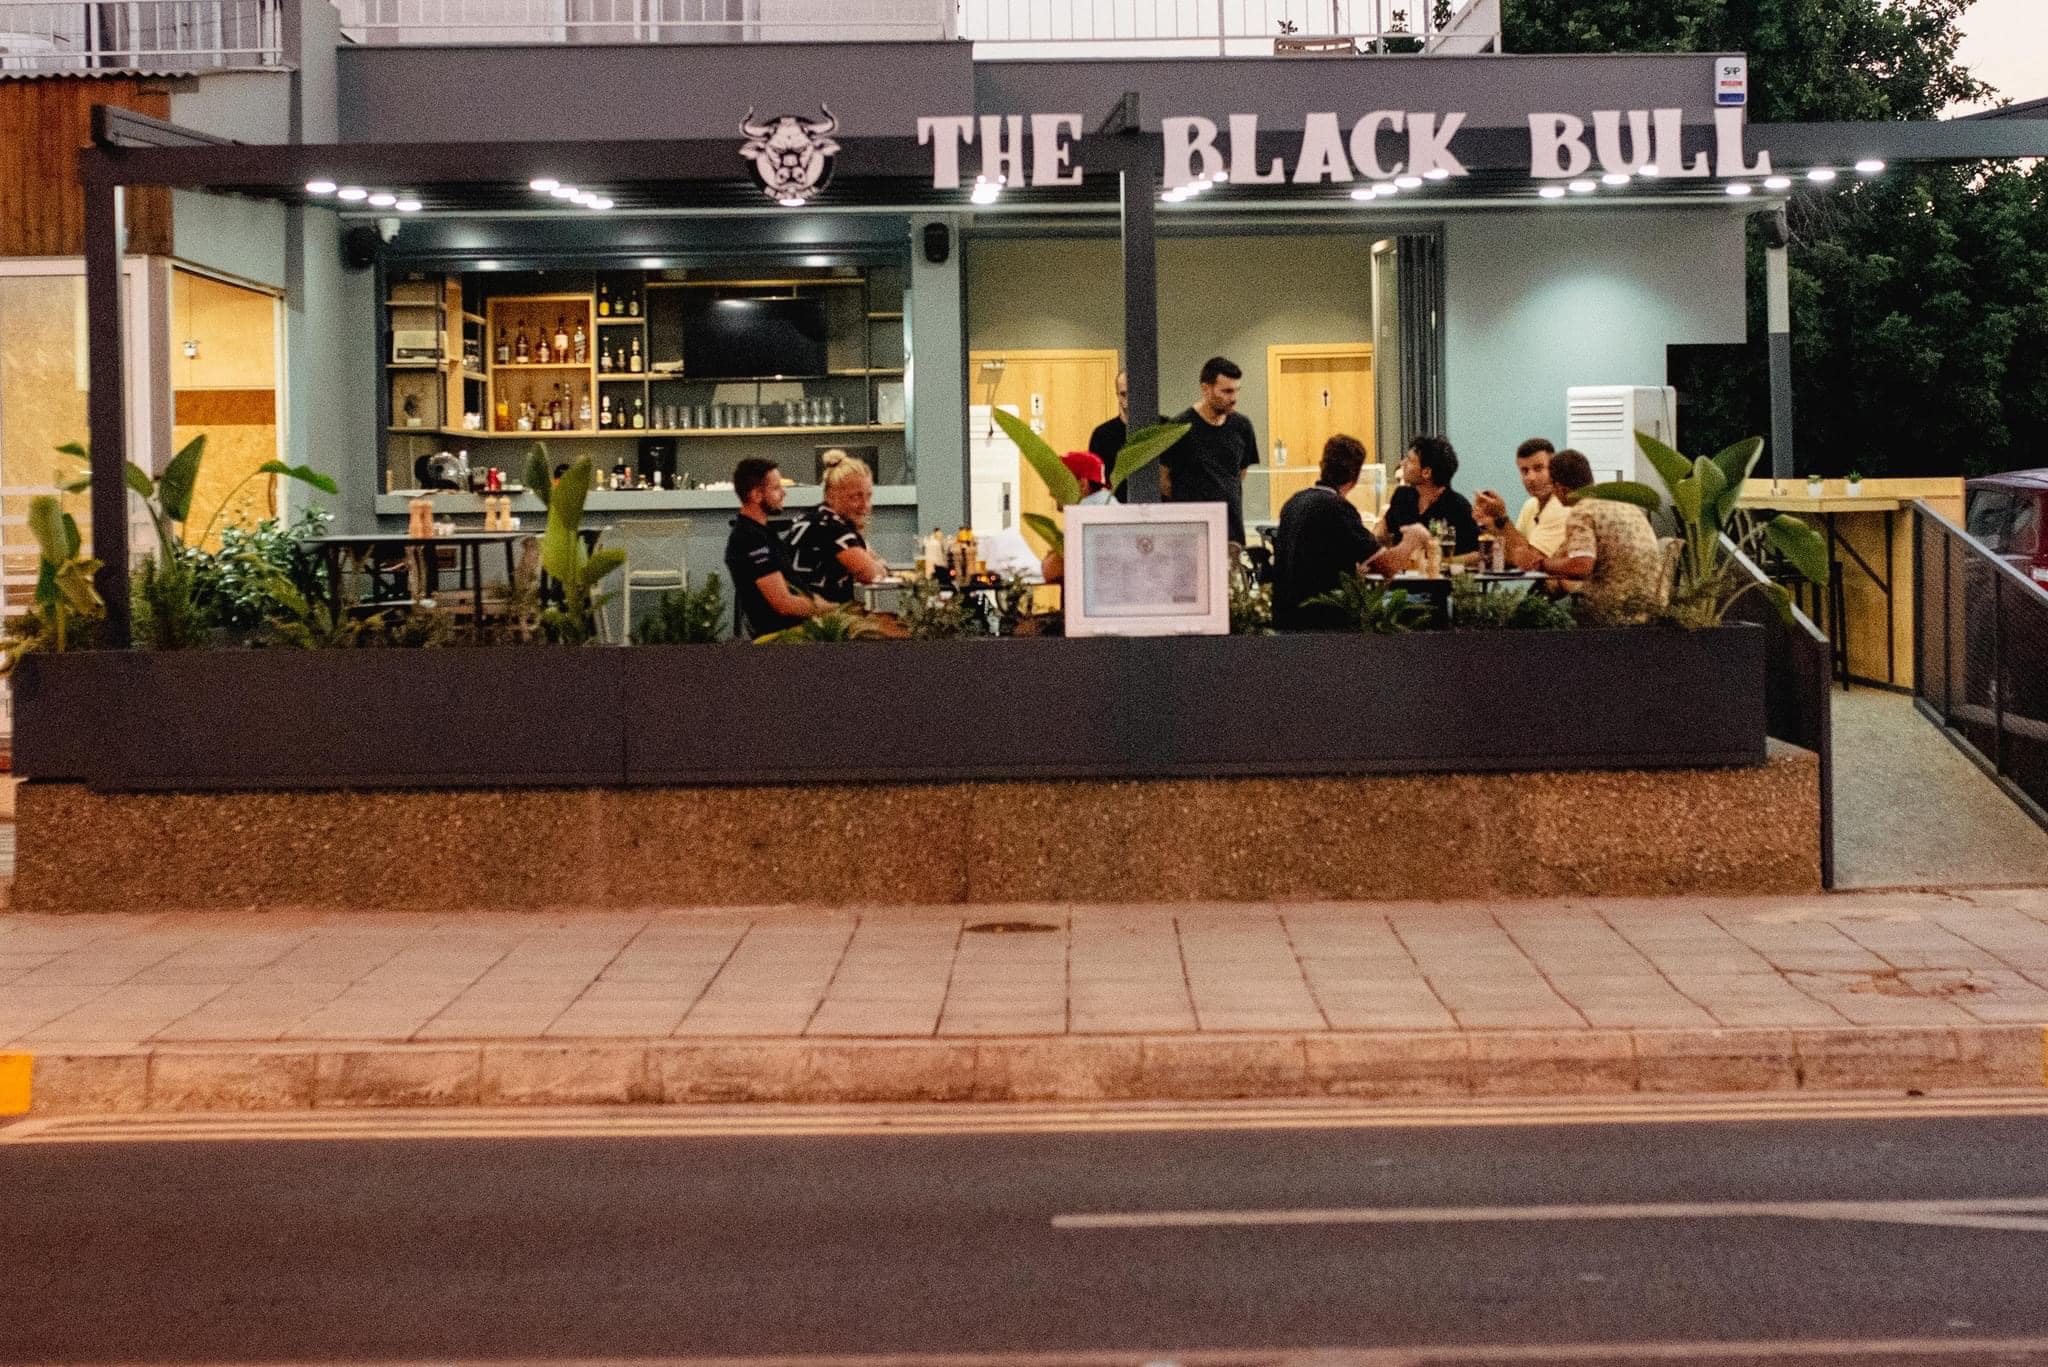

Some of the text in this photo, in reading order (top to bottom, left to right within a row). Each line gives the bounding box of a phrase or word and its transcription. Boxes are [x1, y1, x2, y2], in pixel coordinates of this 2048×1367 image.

[917, 108, 1772, 188] THE BLACK BULL
